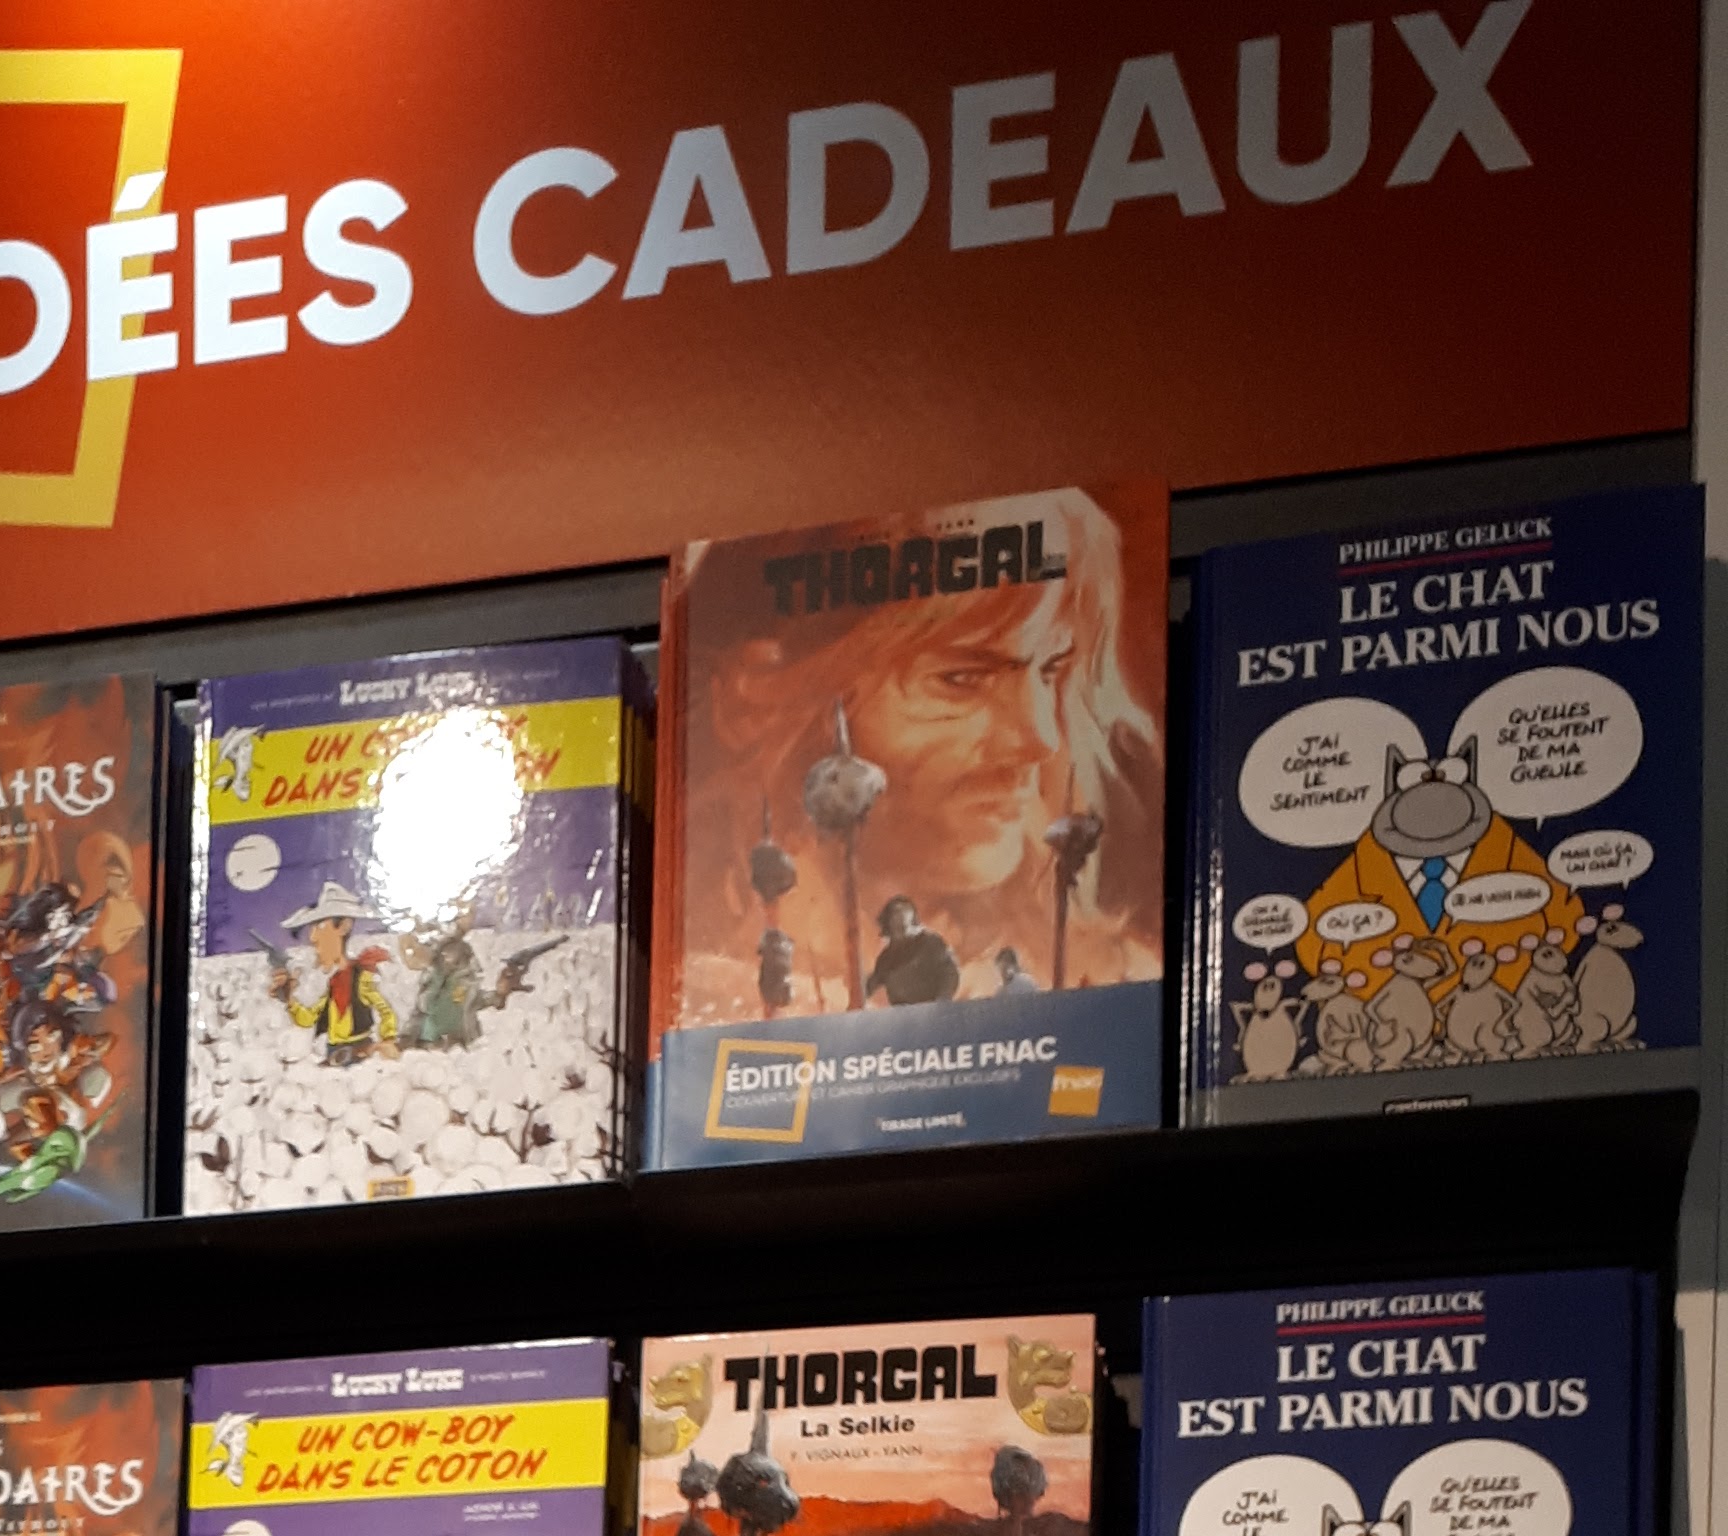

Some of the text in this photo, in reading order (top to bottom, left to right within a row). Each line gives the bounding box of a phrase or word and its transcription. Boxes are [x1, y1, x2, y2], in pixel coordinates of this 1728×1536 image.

[472, 2, 1534, 318] CADEAUX
[1339, 517, 1553, 566] PHILIPPE GELUCK
[764, 520, 1067, 616] THORGAL
[1339, 560, 1554, 625] LE CHAT
[1236, 600, 1661, 687] EST PARMI NOUS
[339, 677, 411, 706] LUCKY
[306, 732, 354, 764] UN
[264, 768, 362, 808] DANS
[725, 1035, 1057, 1092] ÉDITION SPÉCIALE FNAC
[1276, 1290, 1484, 1325] PHILIPPE GELUCK
[725, 1345, 997, 1411] THORGAL
[1276, 1333, 1487, 1383] LE CHAT
[801, 1415, 916, 1438] La Selkie
[1177, 1378, 1589, 1437] EST PARMI NOUS
[298, 1414, 515, 1452] UN COW-BOY
[257, 1449, 548, 1493] DANS LE COTON
